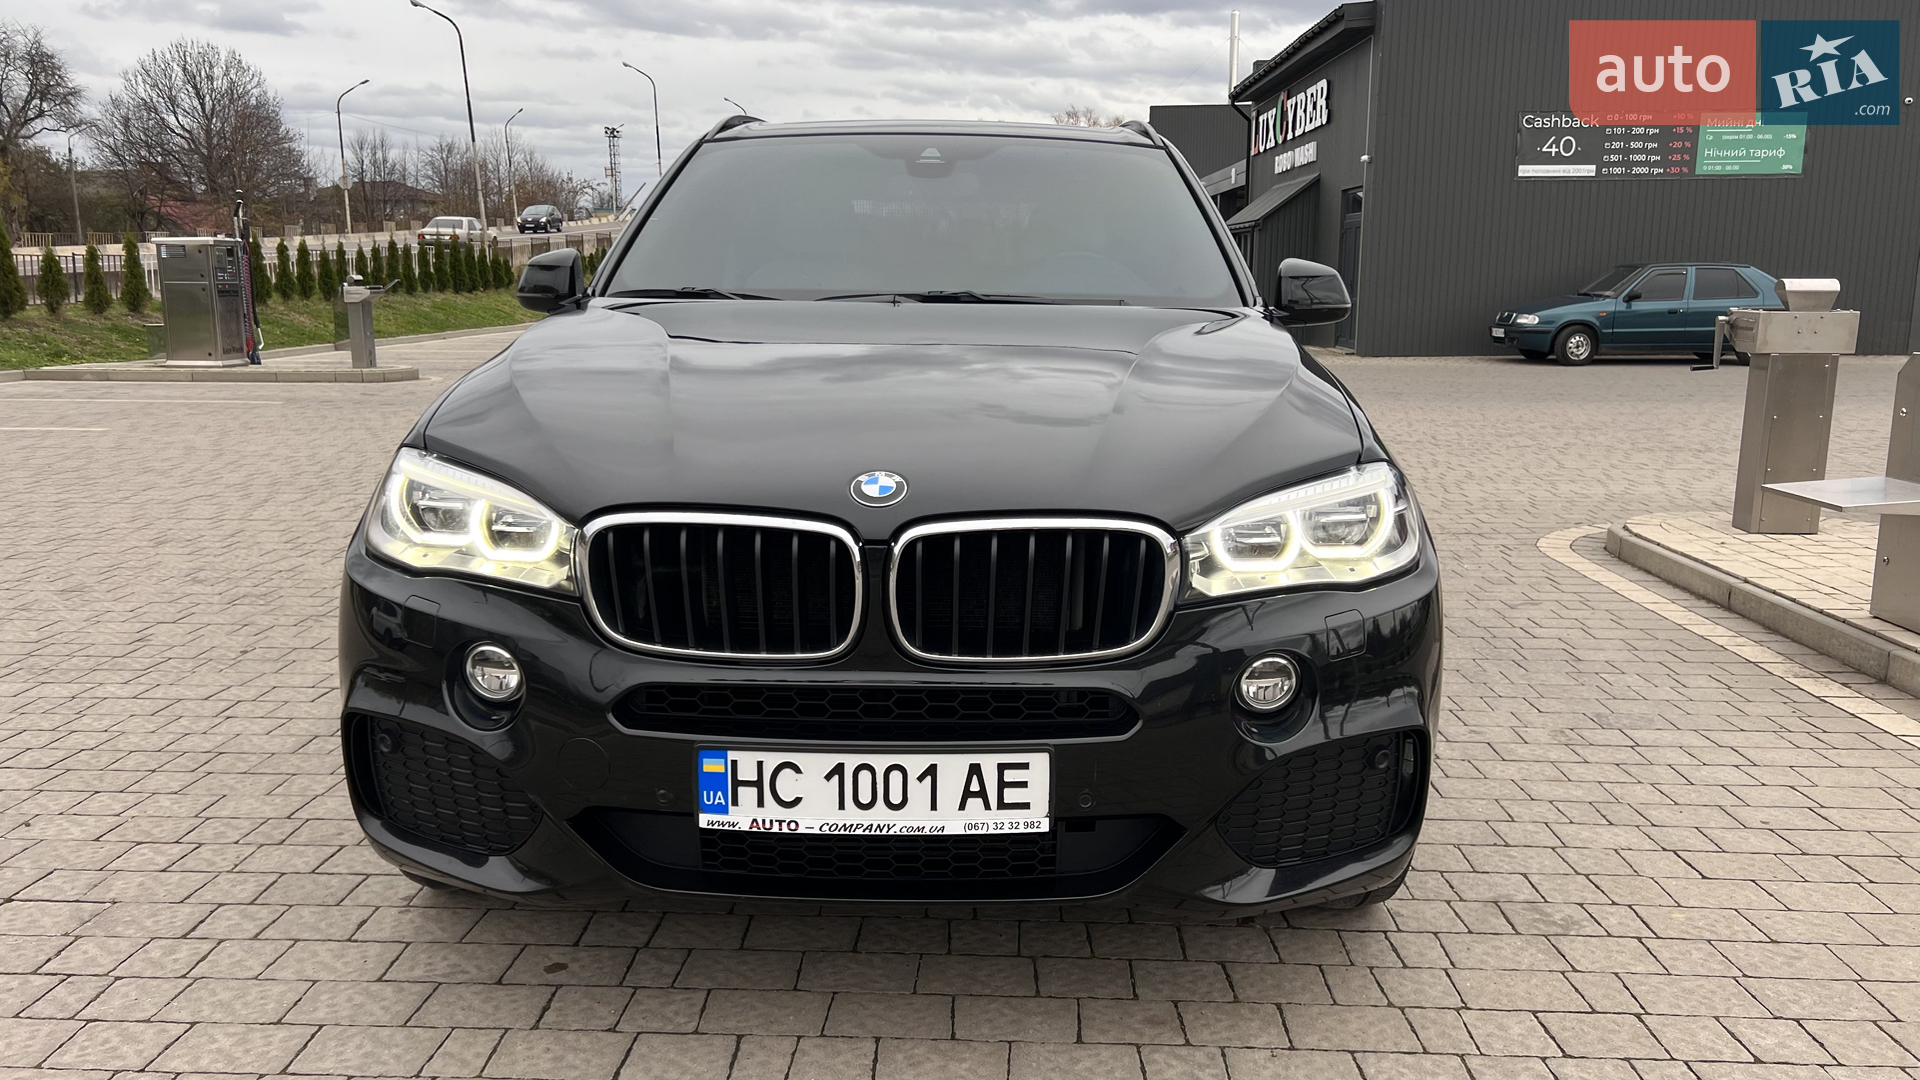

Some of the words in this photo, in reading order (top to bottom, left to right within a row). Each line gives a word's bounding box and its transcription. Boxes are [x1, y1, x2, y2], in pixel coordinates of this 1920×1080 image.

[1522, 114, 1600, 128] Cashback
[1704, 147, 1746, 157] Нічний
[1749, 147, 1786, 158] тариф
[730, 759, 803, 809] HC
[823, 762, 938, 811] 1001
[958, 762, 1031, 811] AE
[703, 791, 725, 805] UA
[750, 818, 800, 832] AUTO
[964, 822, 989, 832] (067)
[992, 822, 1005, 830] 32
[1008, 821, 1020, 830] 32
[1023, 821, 1042, 830] 982
